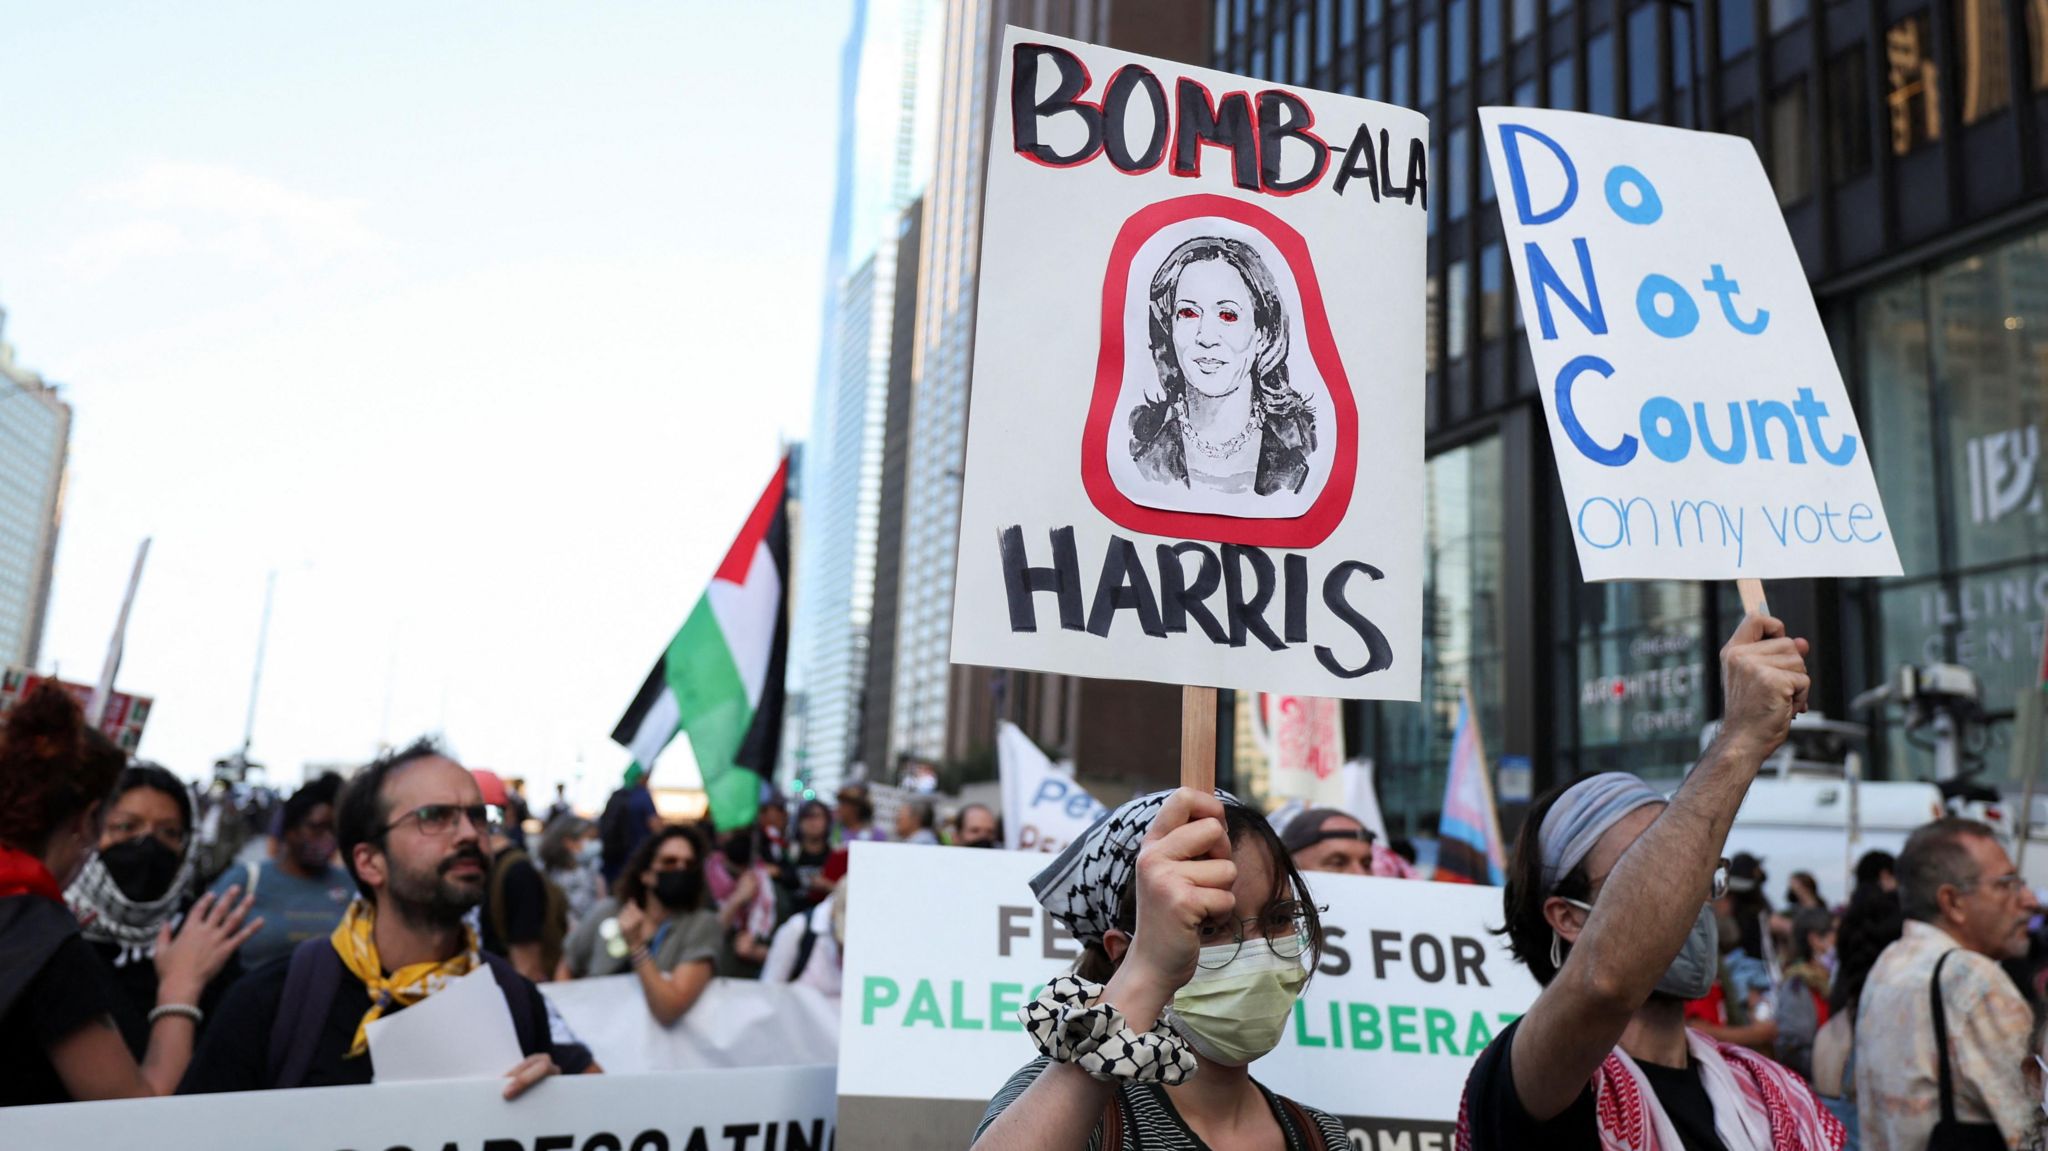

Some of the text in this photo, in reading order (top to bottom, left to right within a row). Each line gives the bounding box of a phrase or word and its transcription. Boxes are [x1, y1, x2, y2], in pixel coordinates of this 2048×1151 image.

[1011, 42, 1428, 211] BOMB-ALA
[1498, 123, 1664, 226] Do
[1524, 237, 1770, 340] Not
[1554, 355, 1858, 468] Count
[1673, 497, 1743, 568] my
[1762, 500, 1883, 548] vote
[997, 524, 1393, 679] HARRIS
[861, 975, 1046, 1032] PALE
[1370, 929, 1492, 987] FOR
